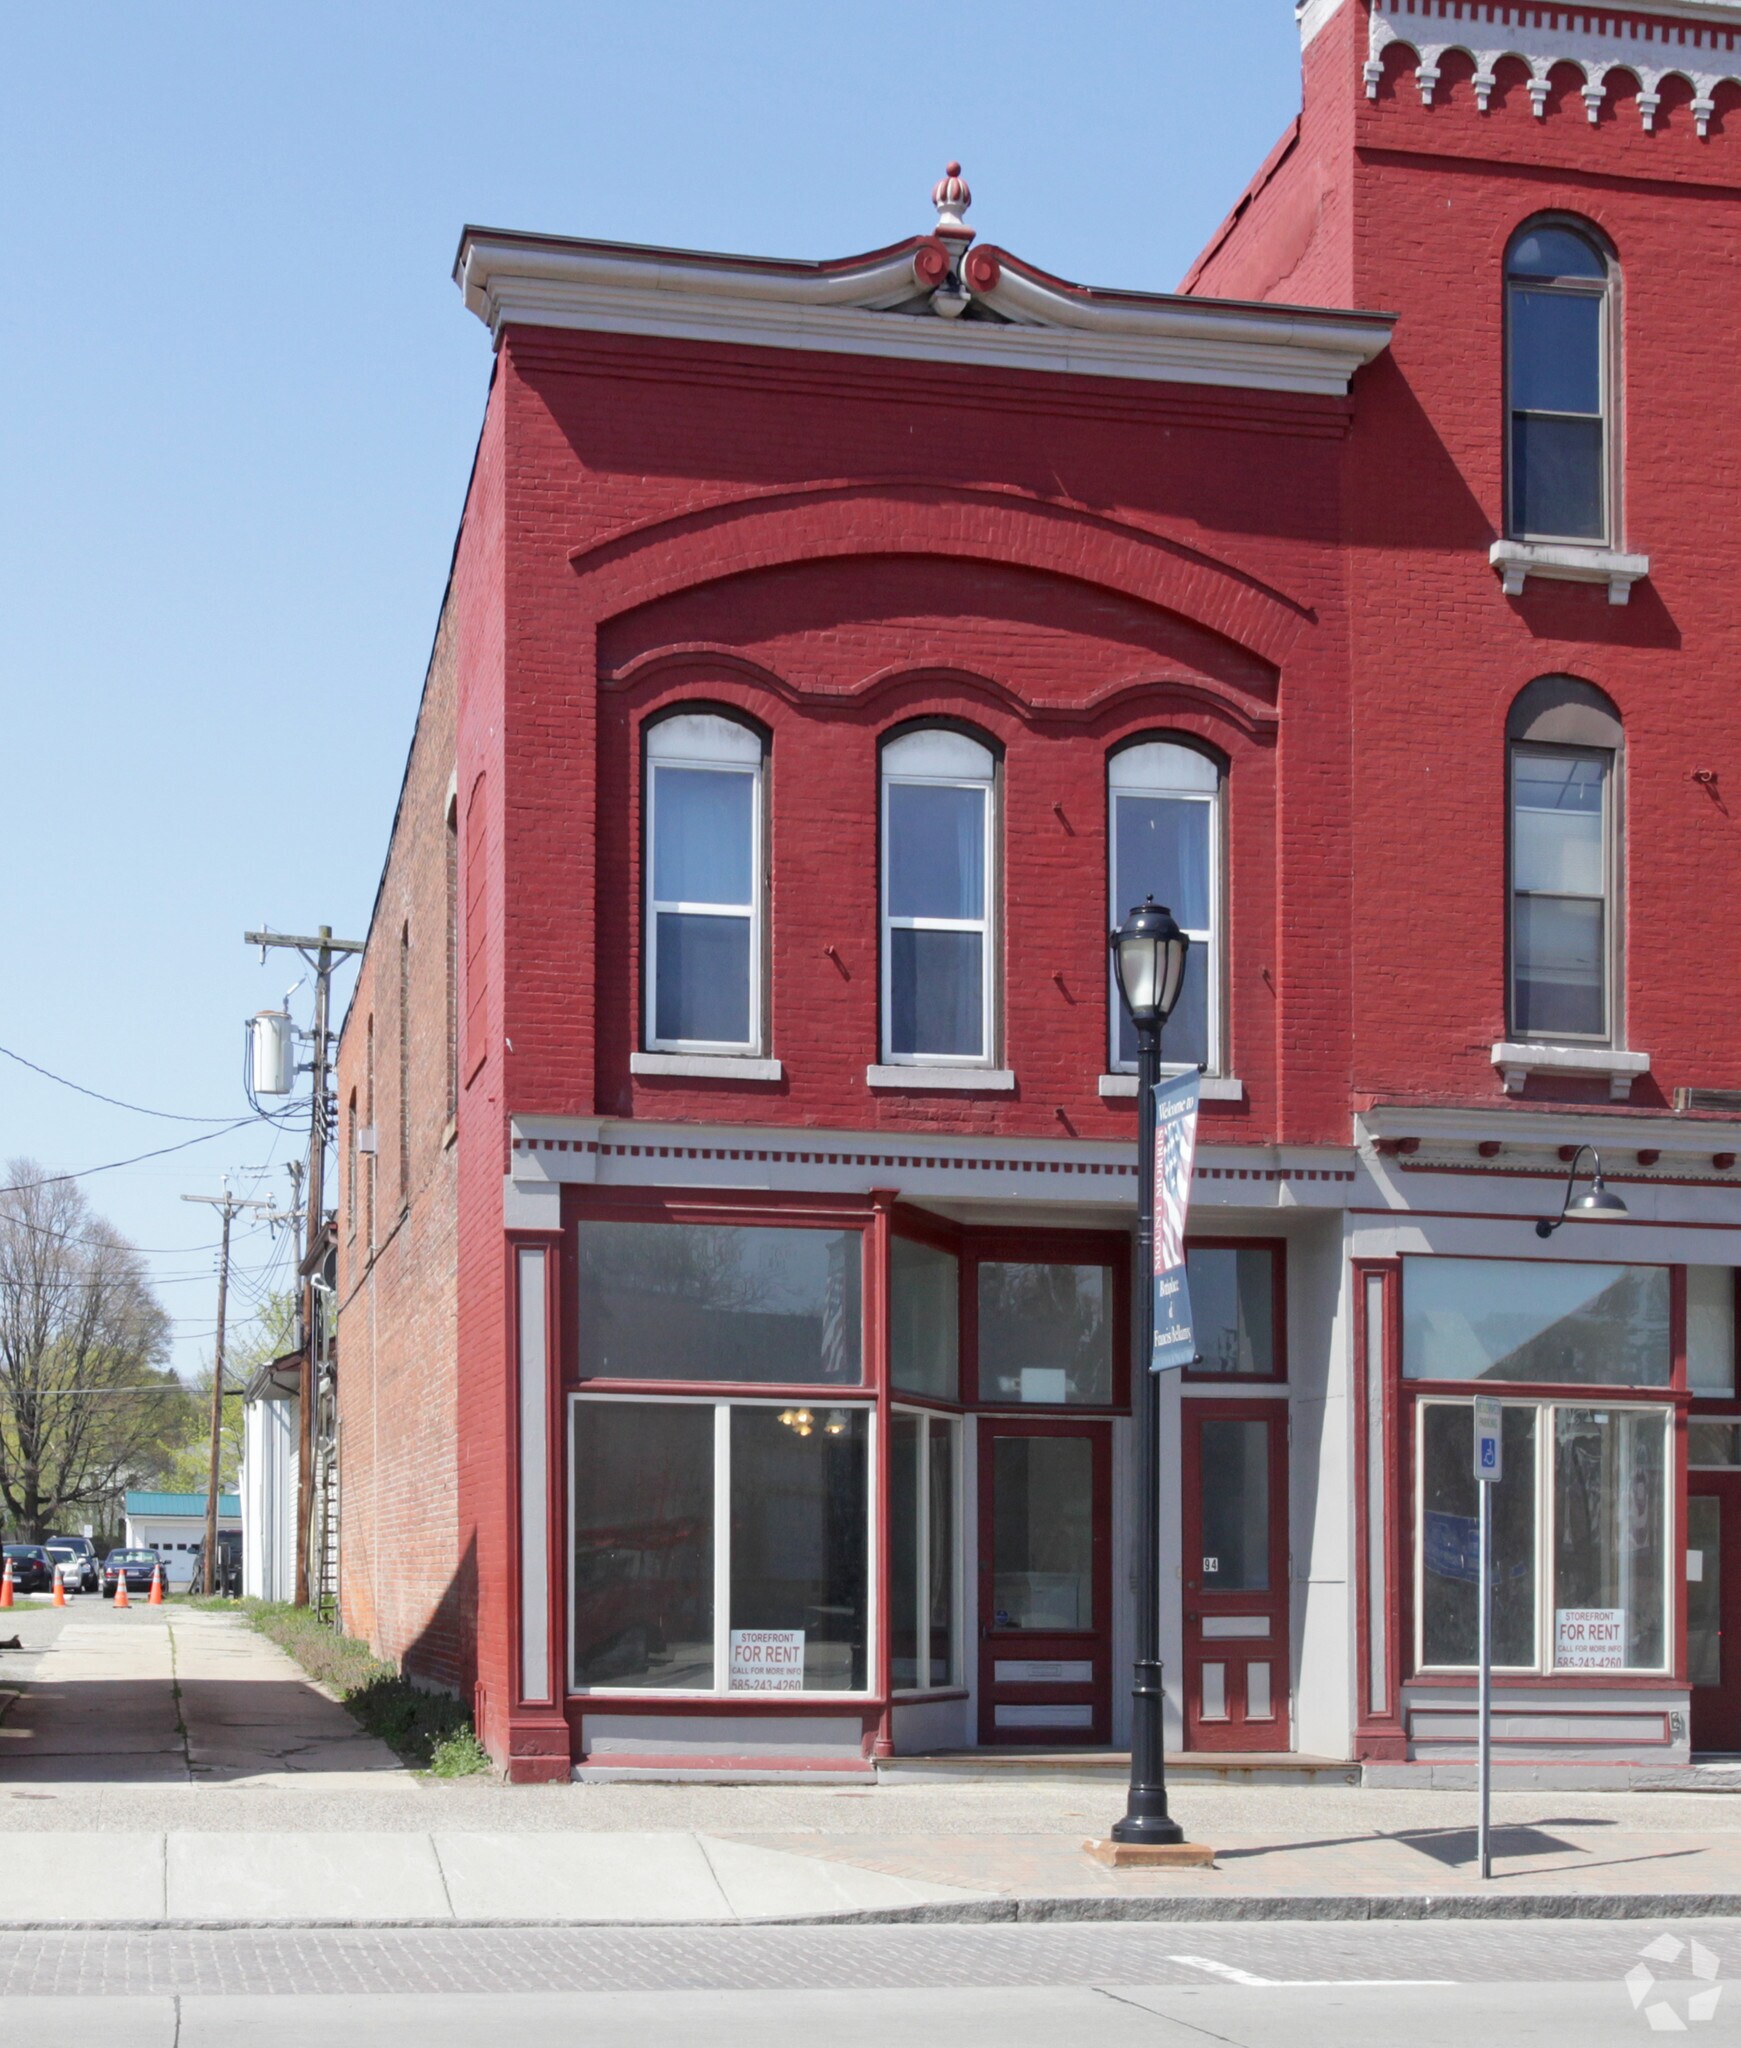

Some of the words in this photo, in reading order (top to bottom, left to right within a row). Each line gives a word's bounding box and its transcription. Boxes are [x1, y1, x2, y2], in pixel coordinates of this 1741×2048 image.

[1159, 1099, 1186, 1121] Welcome
[1186, 1096, 1194, 1110] to
[1155, 1129, 1164, 1197] MORRIS
[1154, 1203, 1162, 1270] MOUNT
[1154, 1327, 1172, 1347] Francis
[1204, 1558, 1217, 1571] 94
[1565, 1612, 1614, 1621] STOREFRONT
[741, 1633, 794, 1642] STOREFRONT
[1560, 1624, 1584, 1640] FOR
[1589, 1624, 1620, 1640] RENT
[735, 1645, 761, 1662] FOR
[765, 1646, 800, 1663] RENT
[1557, 1657, 1622, 1668] 585-243-4260
[751, 1667, 764, 1675] FOR
[732, 1679, 801, 1690] 585-243-4260
